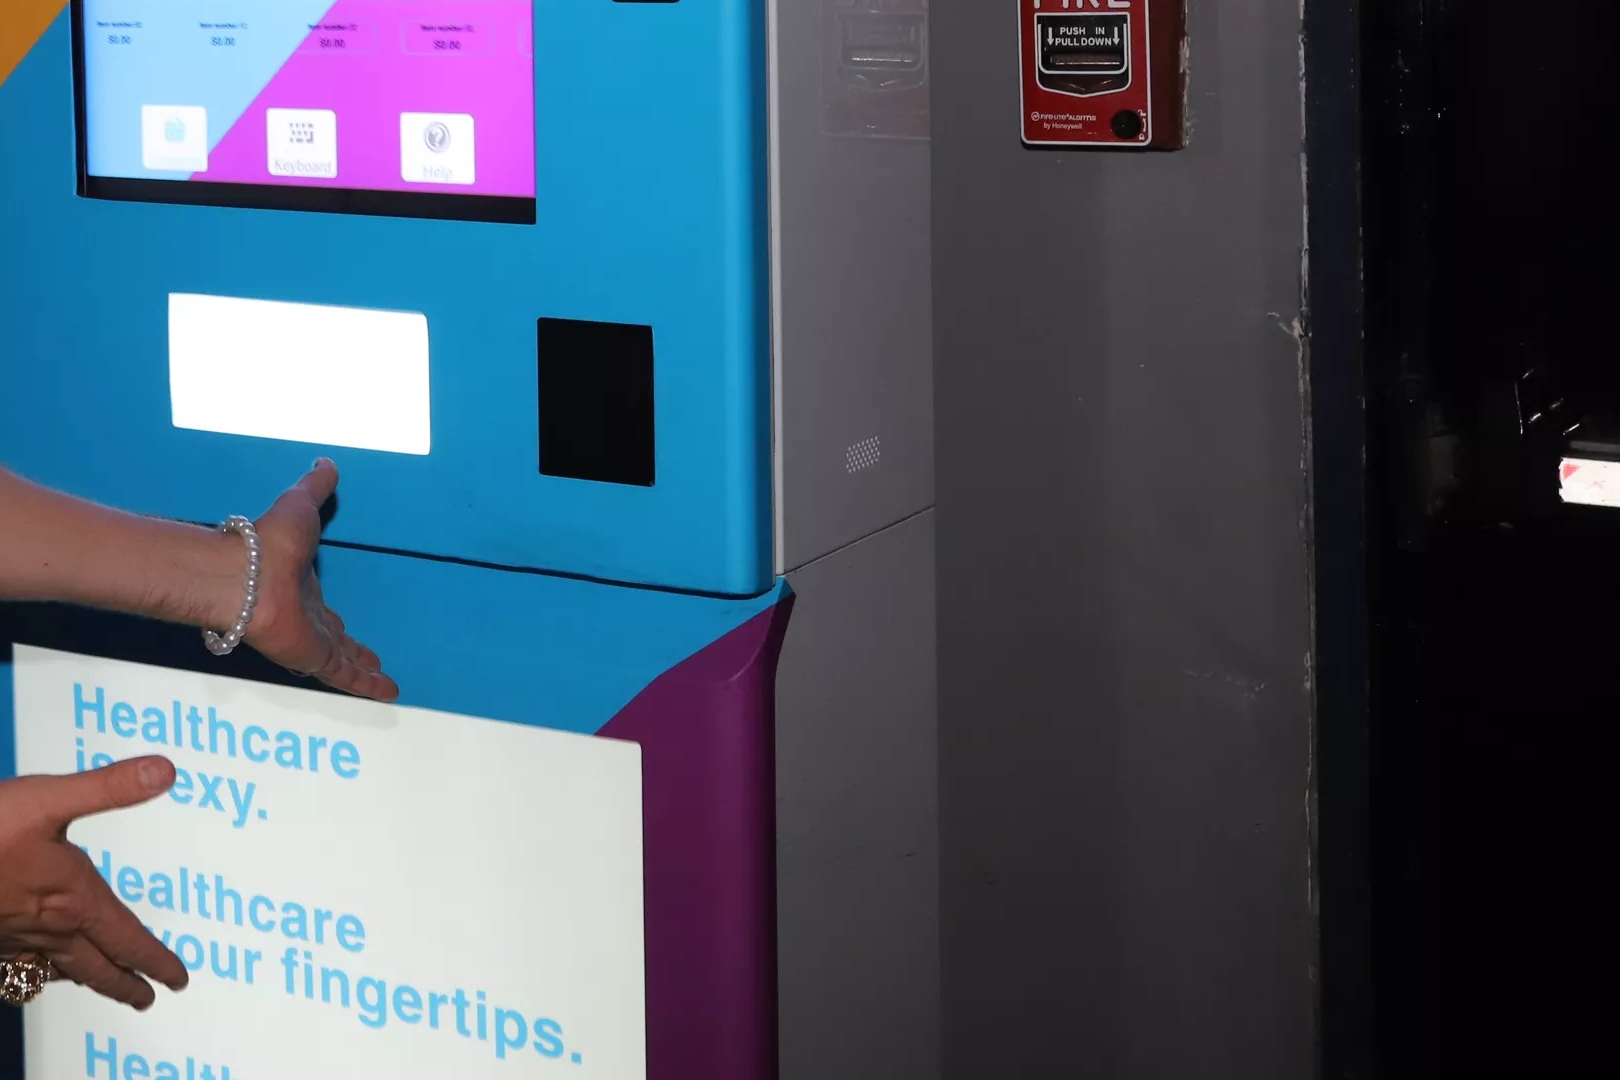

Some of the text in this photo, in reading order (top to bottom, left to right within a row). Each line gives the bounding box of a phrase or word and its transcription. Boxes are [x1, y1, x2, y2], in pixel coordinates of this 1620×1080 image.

[1060, 26, 1105, 36] PUSH IN
[1055, 37, 1112, 47] PULL DOWN
[1043, 122, 1083, 131] by Honeywell
[274, 158, 333, 174] Keyboard
[422, 164, 453, 180] Help
[73, 682, 361, 780] Healthcare
[167, 765, 268, 829] exy.
[281, 946, 583, 1064] fingertips.
